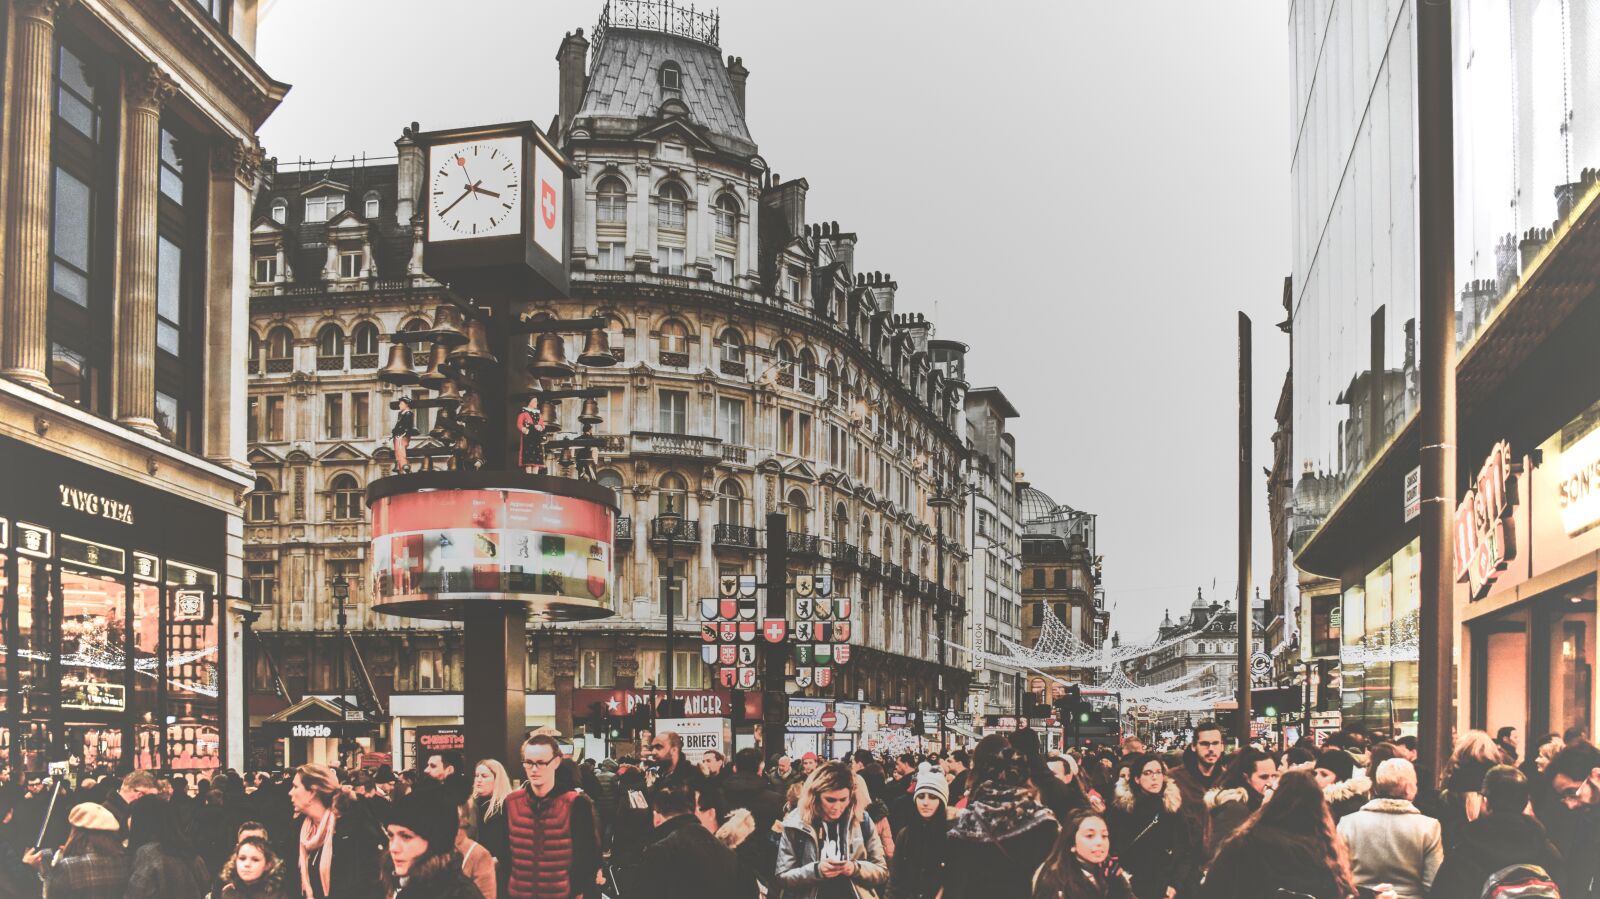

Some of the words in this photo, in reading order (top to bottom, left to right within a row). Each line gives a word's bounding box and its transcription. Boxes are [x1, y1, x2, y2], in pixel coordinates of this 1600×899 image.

[59, 484, 98, 514] TWG
[100, 497, 134, 525] TEA
[675, 694, 722, 714] ANGER
[785, 717, 824, 727] XCHANG
[292, 724, 332, 737] thistle
[420, 735, 464, 745] CHRISTM
[686, 734, 717, 748] BRIEFS
